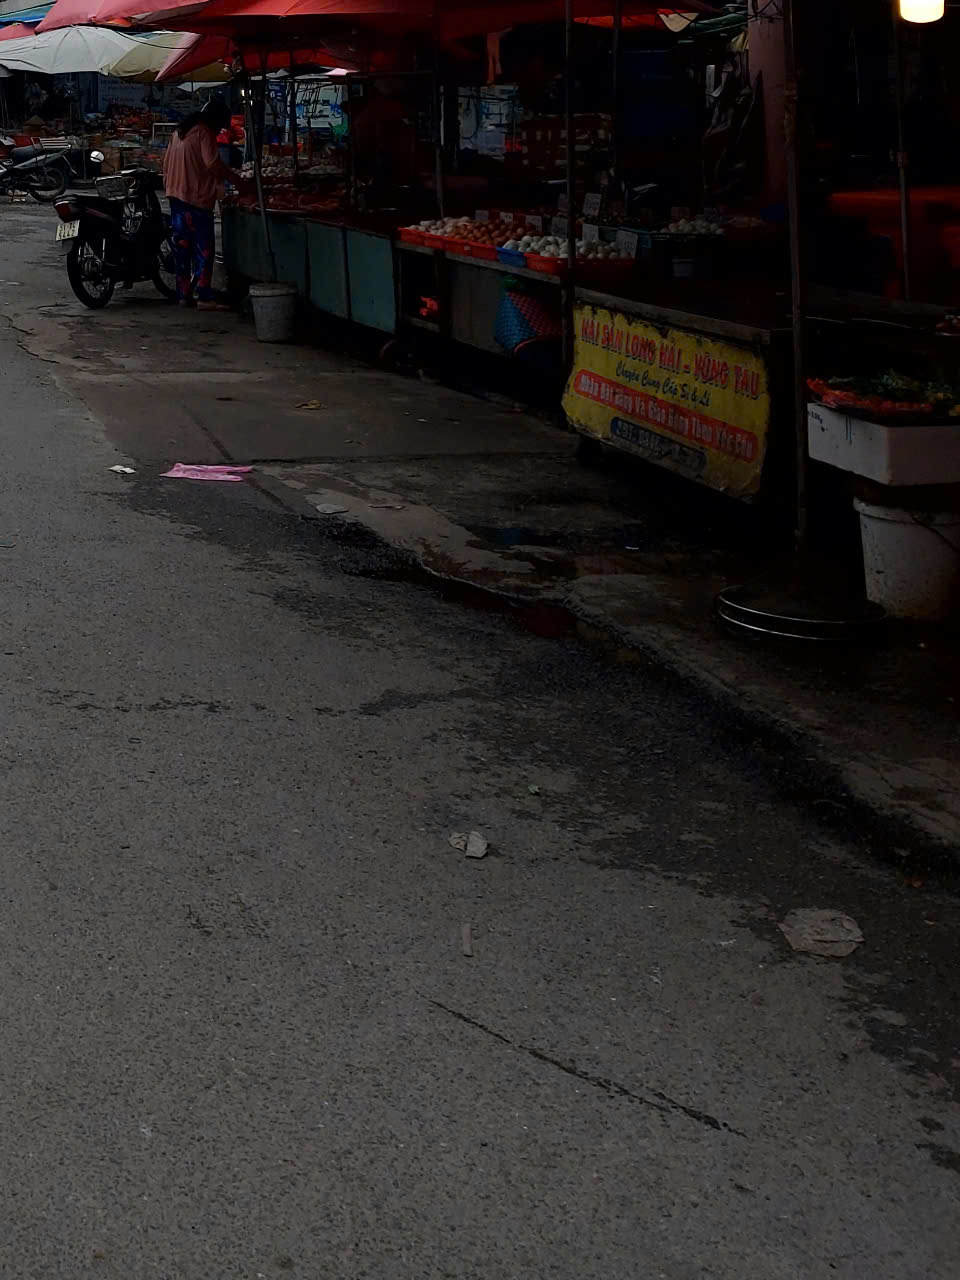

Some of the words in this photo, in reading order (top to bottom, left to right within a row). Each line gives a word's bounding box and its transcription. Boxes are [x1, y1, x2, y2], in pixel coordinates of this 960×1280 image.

[625, 330, 656, 364] LONG
[641, 370, 660, 393] Cung
[662, 377, 678, 397] Cấp
